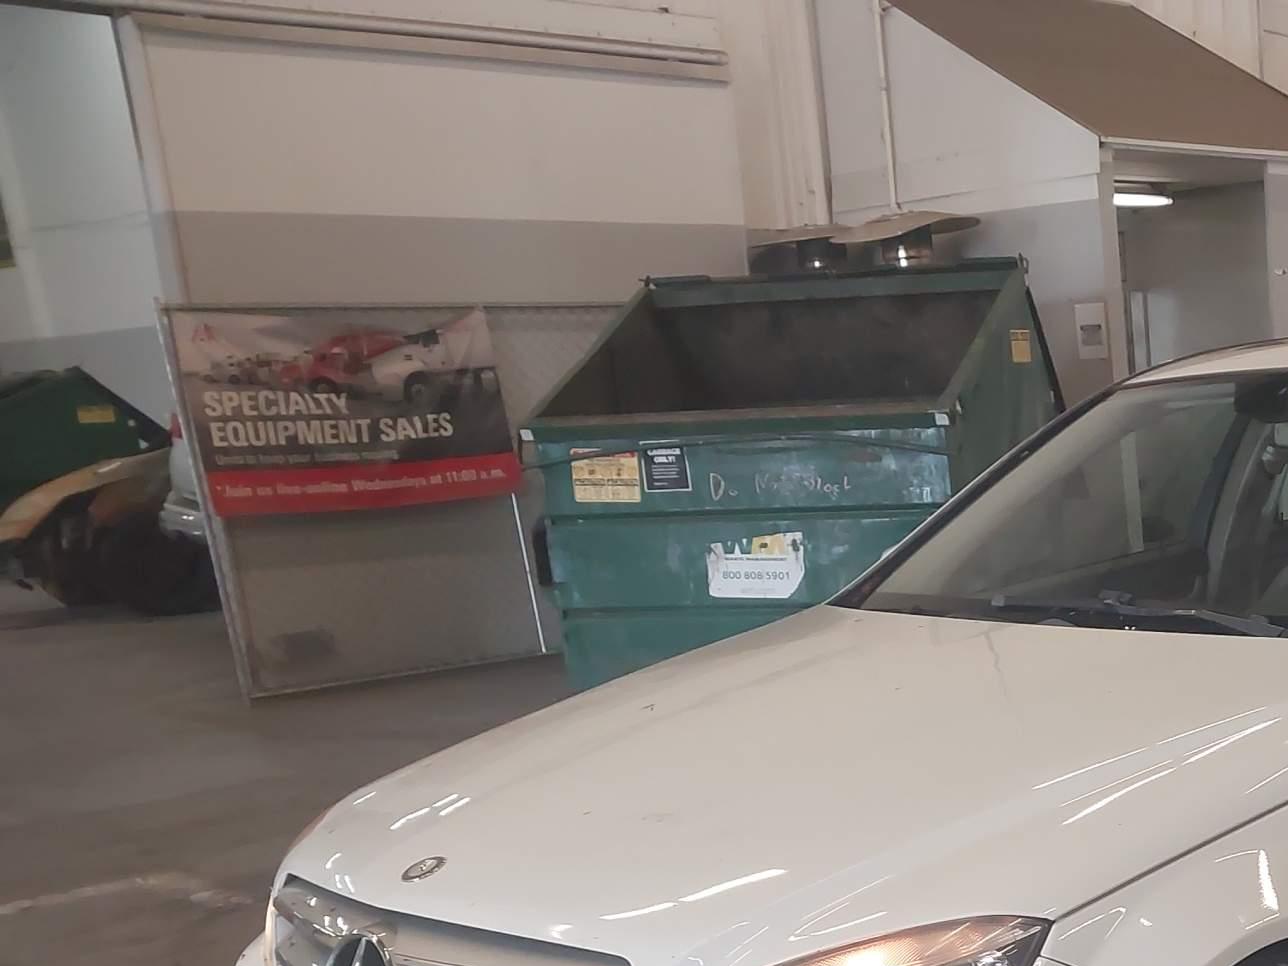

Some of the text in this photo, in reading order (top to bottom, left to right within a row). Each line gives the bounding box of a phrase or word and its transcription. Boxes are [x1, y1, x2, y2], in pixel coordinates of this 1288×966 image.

[204, 389, 349, 416] SPECIALTY
[209, 412, 453, 447] EQUIPMENT SALES
[722, 571, 741, 580] 800
[765, 571, 791, 581] 5901
